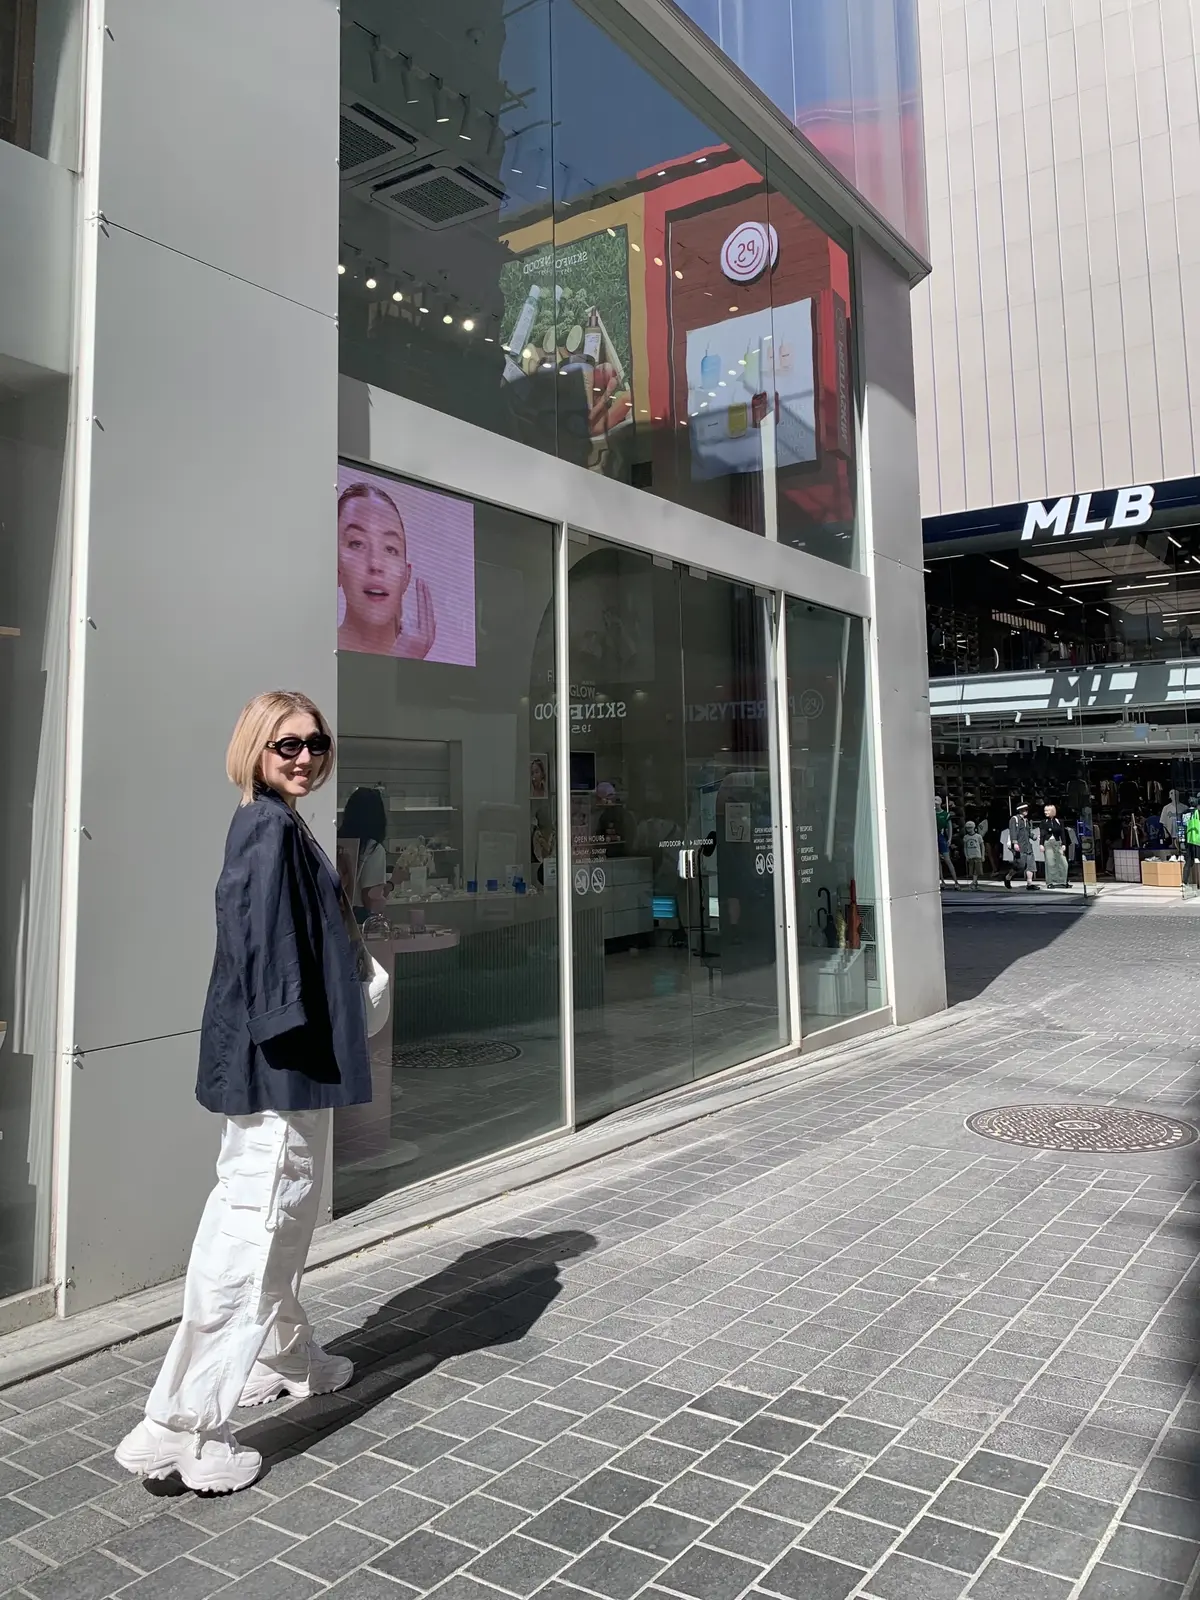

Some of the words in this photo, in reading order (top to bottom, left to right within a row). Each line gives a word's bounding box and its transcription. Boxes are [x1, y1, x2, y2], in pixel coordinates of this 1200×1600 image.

[1020, 485, 1155, 540] MLB
[570, 685, 595, 699] GLOW
[658, 840, 669, 848] AUTO
[669, 839, 681, 848] DOOR
